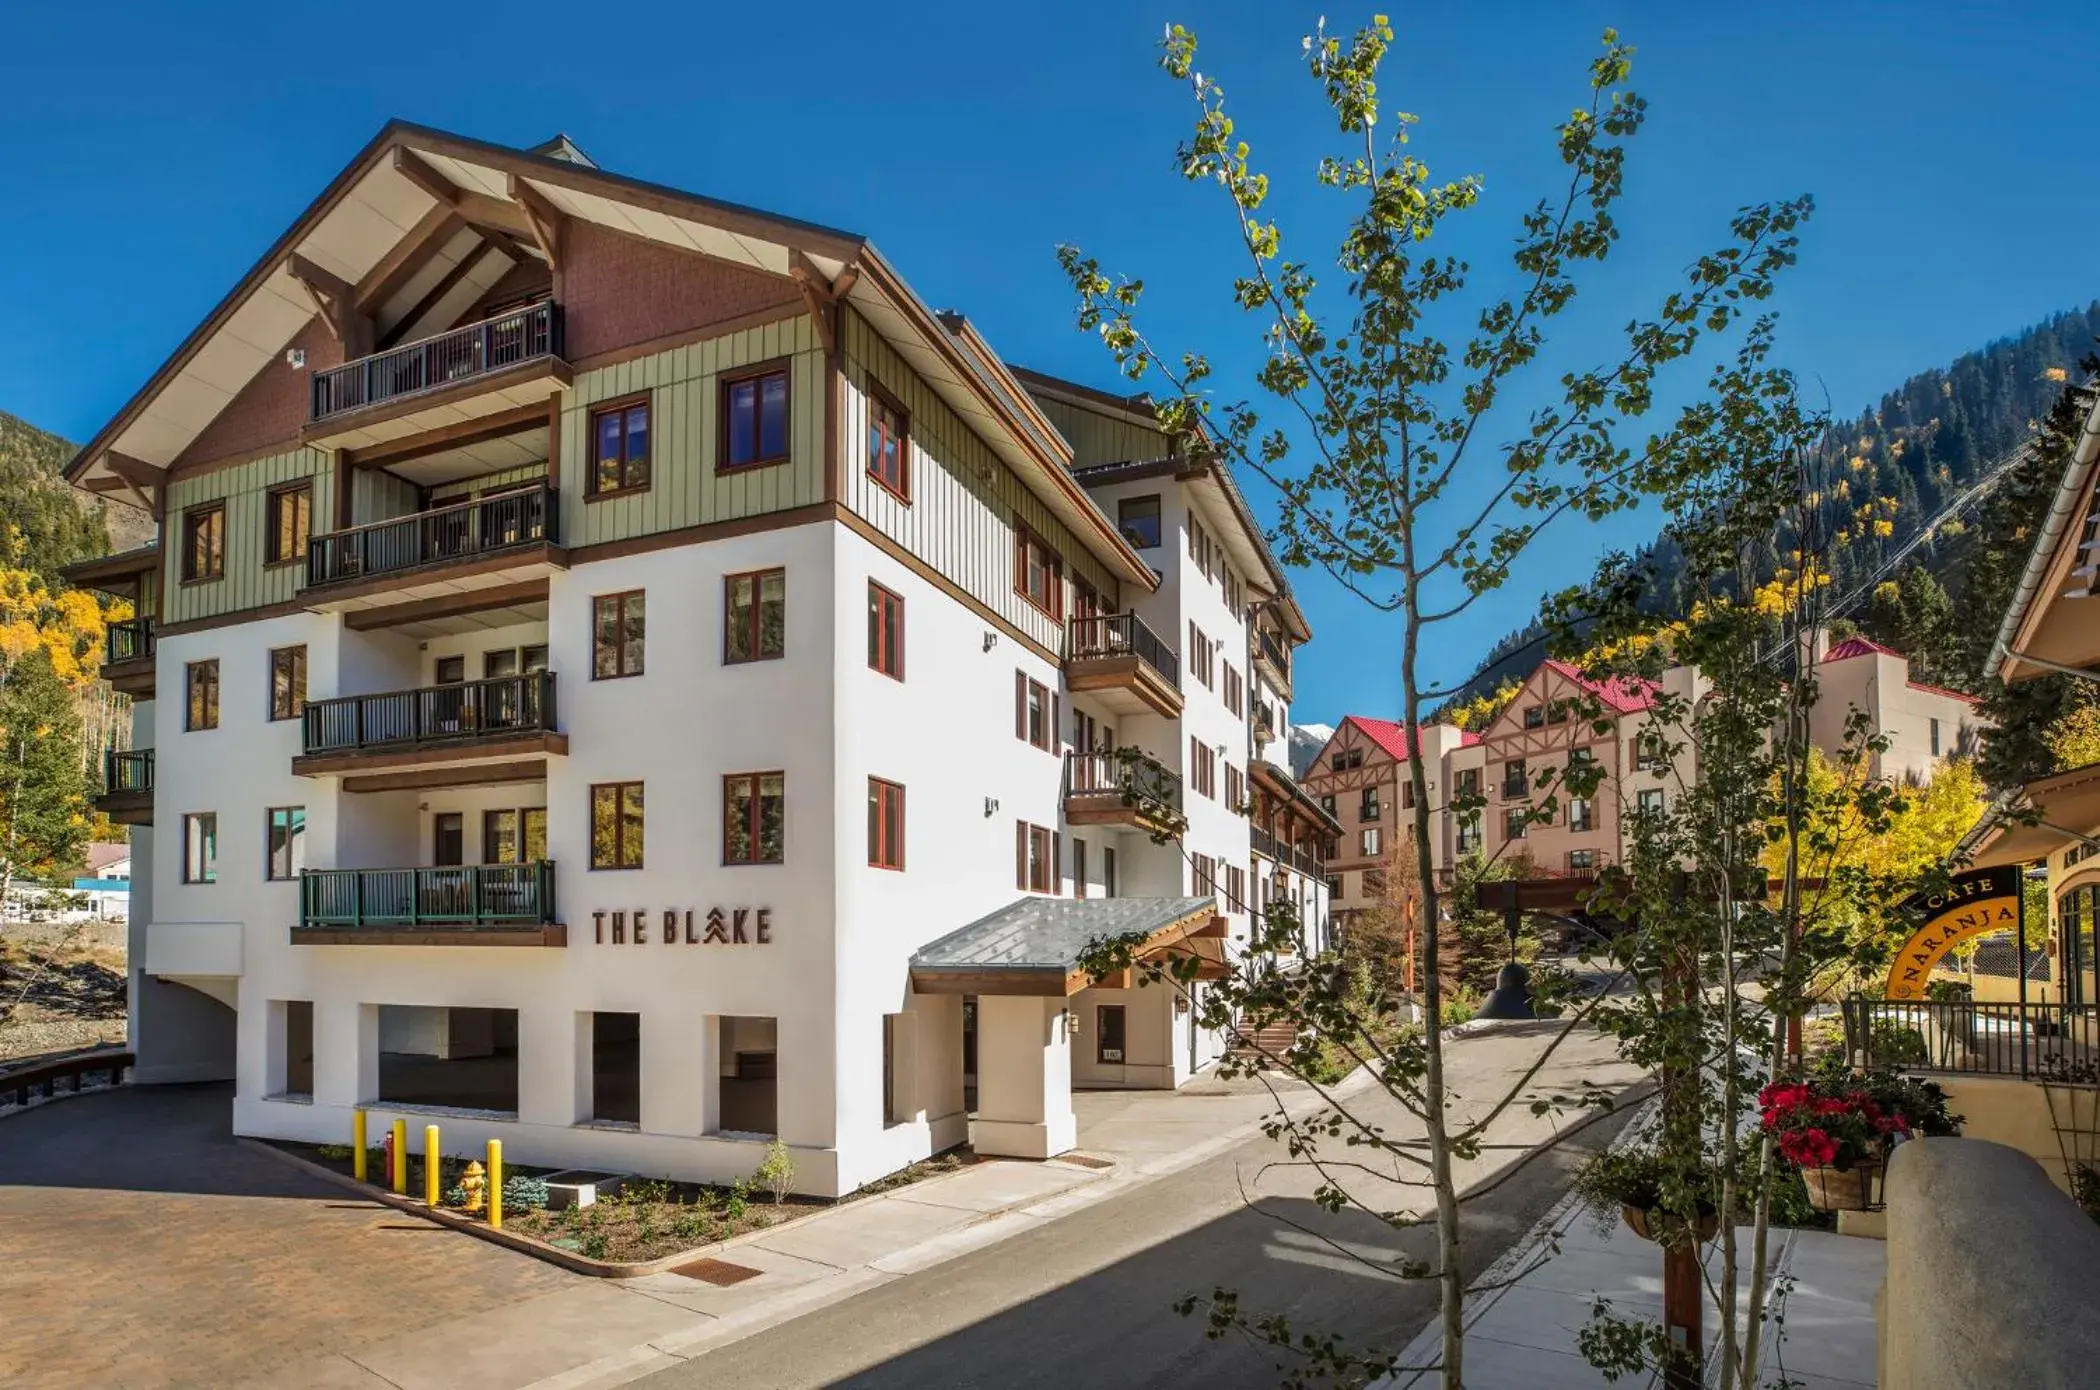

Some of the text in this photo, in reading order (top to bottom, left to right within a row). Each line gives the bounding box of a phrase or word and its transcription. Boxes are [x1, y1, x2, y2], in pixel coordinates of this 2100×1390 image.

[1928, 878, 1993, 909] CAFE
[592, 907, 772, 945] THE BLAKE
[1903, 907, 2015, 983] NARANJA
